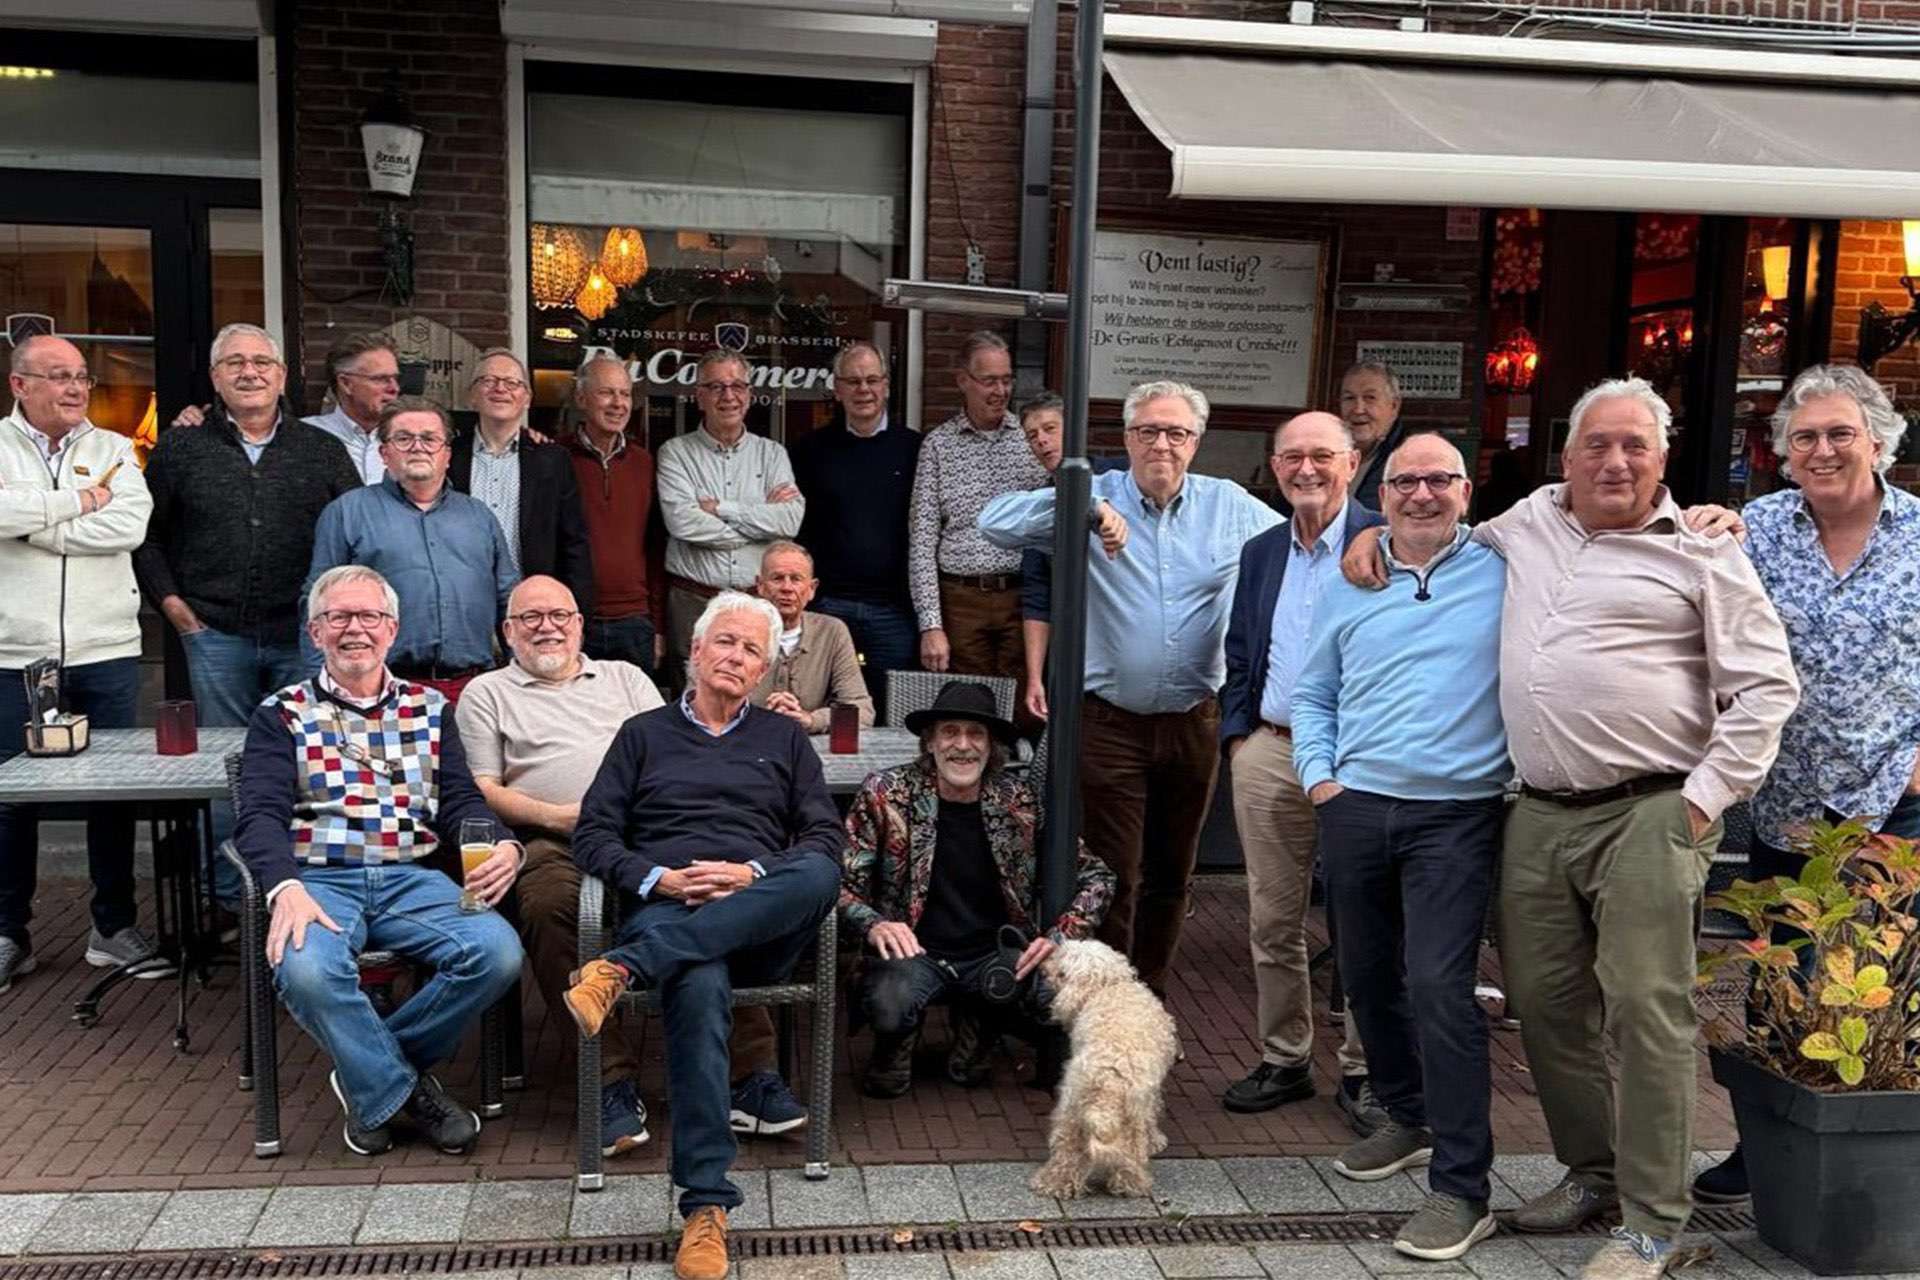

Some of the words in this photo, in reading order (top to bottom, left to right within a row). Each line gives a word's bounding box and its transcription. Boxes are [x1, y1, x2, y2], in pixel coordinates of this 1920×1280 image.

[376, 150, 410, 164] Brand
[1138, 249, 1190, 273] Vent
[1197, 252, 1262, 282] lastig?
[1128, 279, 1146, 290] Wil
[1148, 281, 1161, 294] hij
[1163, 283, 1183, 292] niet
[1185, 285, 1211, 295] meer
[1214, 285, 1266, 297] winkelen?
[1091, 295, 1109, 305] opt
[1111, 295, 1124, 307] hij
[1126, 296, 1137, 306] te
[1139, 298, 1175, 308] zeuren
[1176, 299, 1190, 311] bij
[1192, 300, 1205, 309] de
[1207, 301, 1255, 312] volgende
[1104, 313, 1123, 327] Wij
[1126, 313, 1169, 328] hebben
[1172, 317, 1188, 328] de
[598, 327, 711, 341] STADSKEFEE
[1090, 329, 1114, 346] De
[1116, 331, 1160, 346] Gratis
